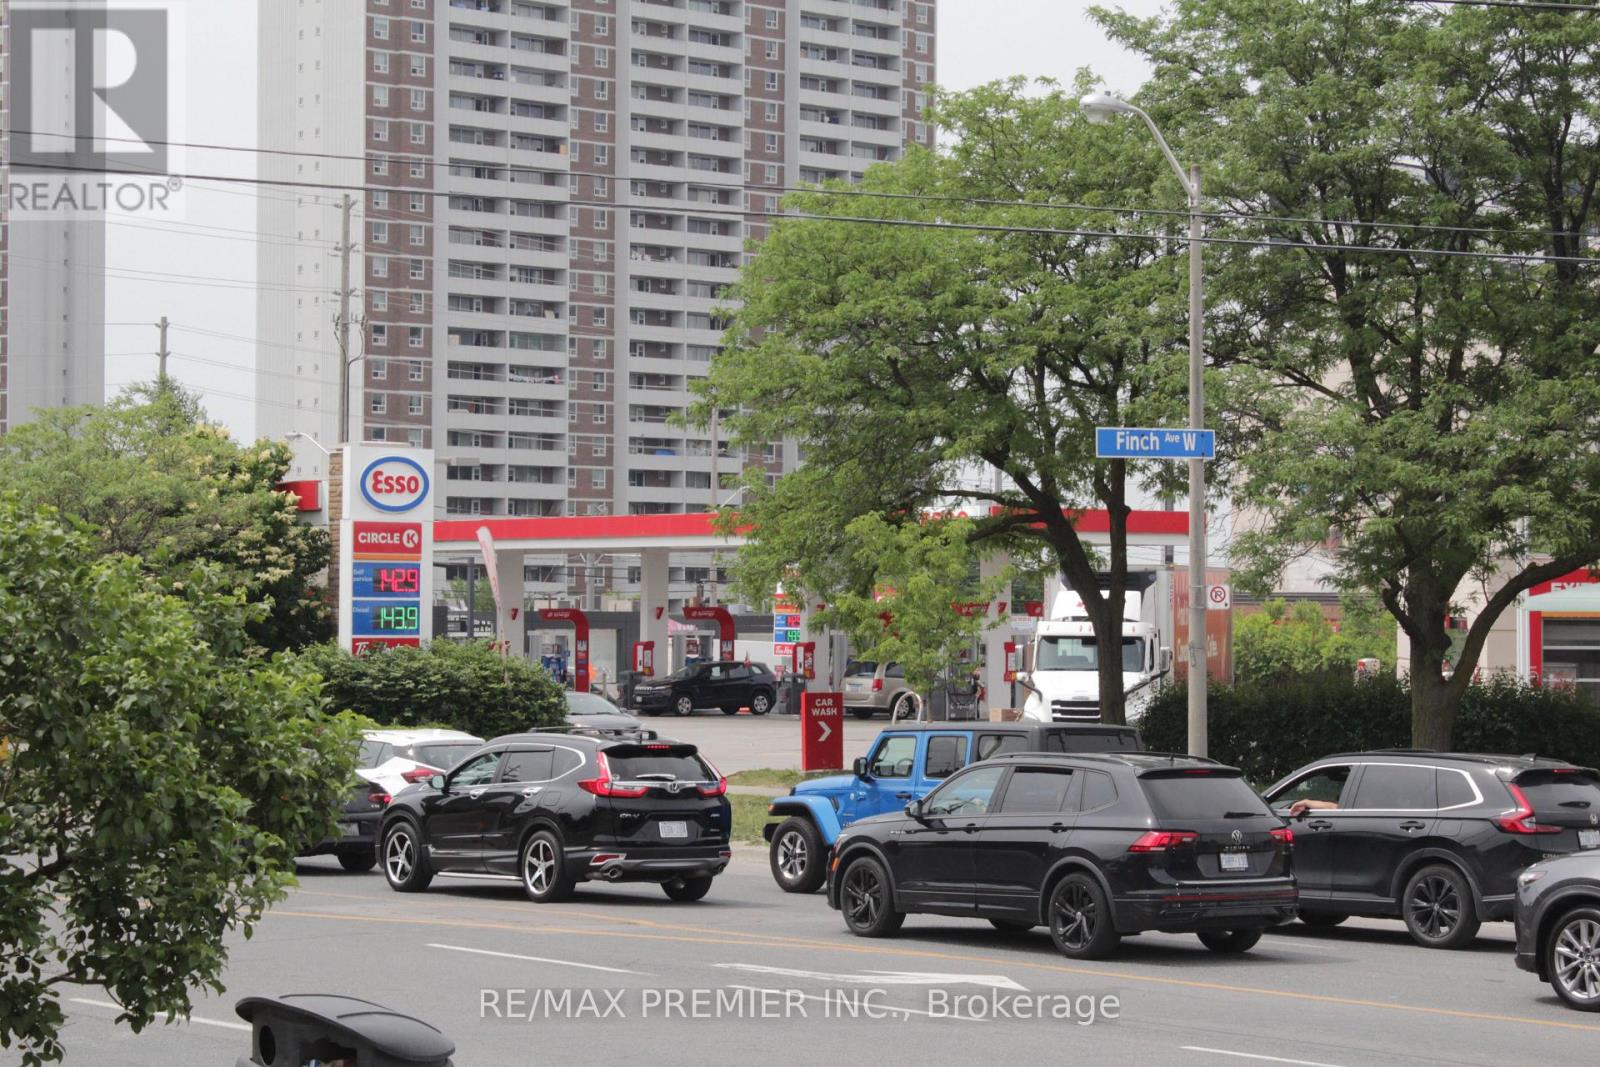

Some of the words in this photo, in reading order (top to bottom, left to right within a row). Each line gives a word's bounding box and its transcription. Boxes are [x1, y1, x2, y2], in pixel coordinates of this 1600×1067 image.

[1116, 431, 1159, 450] Finch
[1165, 432, 1180, 443] Ave
[1183, 433, 1196, 451] W
[372, 470, 419, 494] Esso
[358, 532, 400, 543] CIRCLE
[402, 529, 418, 548] K
[380, 607, 418, 630] 143.9
[811, 707, 838, 716] WASH
[815, 698, 833, 706] CAR
